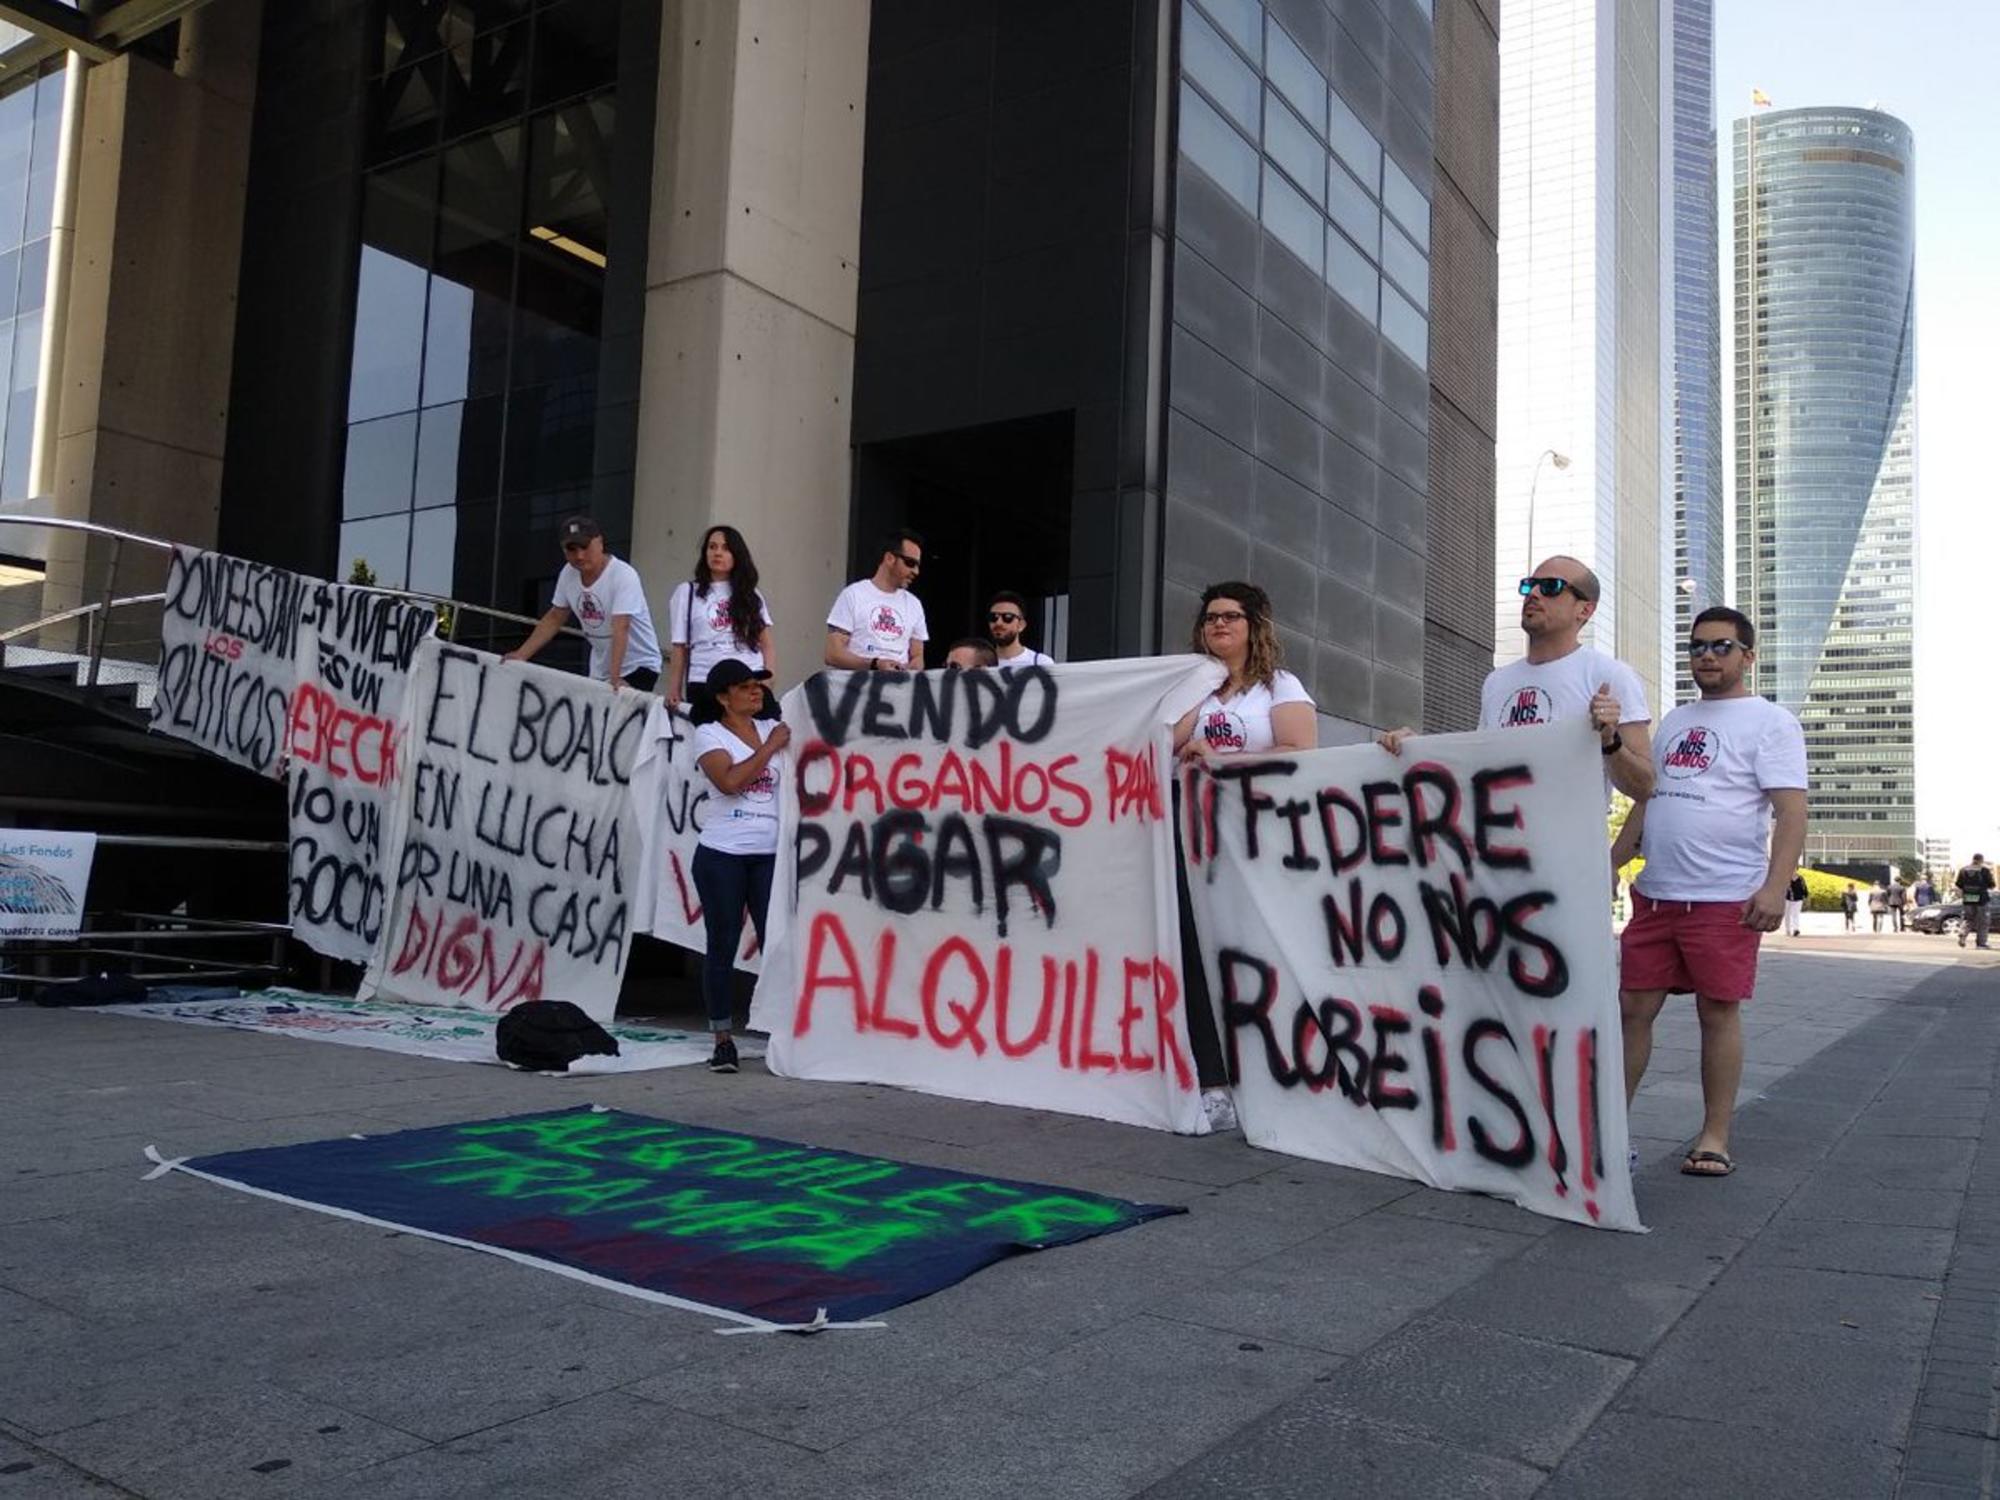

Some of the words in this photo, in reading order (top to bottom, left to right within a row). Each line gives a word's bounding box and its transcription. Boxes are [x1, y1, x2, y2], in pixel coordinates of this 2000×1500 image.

[203, 629, 244, 660] LOS
[351, 663, 383, 715] UN
[426, 648, 498, 765] EL
[804, 665, 1059, 750] VENDO
[1509, 704, 1539, 722] NOS
[1519, 690, 1537, 707] NO
[1204, 723, 1232, 739] NOS
[1664, 753, 1711, 769] VAMOS
[1676, 741, 1707, 757] NOS
[1687, 729, 1708, 742] NO
[414, 760, 460, 830] EN
[797, 739, 1092, 828] ORGANOS
[795, 808, 1062, 938] PAGAR
[447, 850, 514, 929] UNA
[527, 884, 629, 977] CASA
[1322, 877, 1407, 967] NO
[1420, 872, 1569, 998] NOS
[391, 900, 546, 1012] DIGNA
[793, 910, 1195, 1093] ALQUILER
